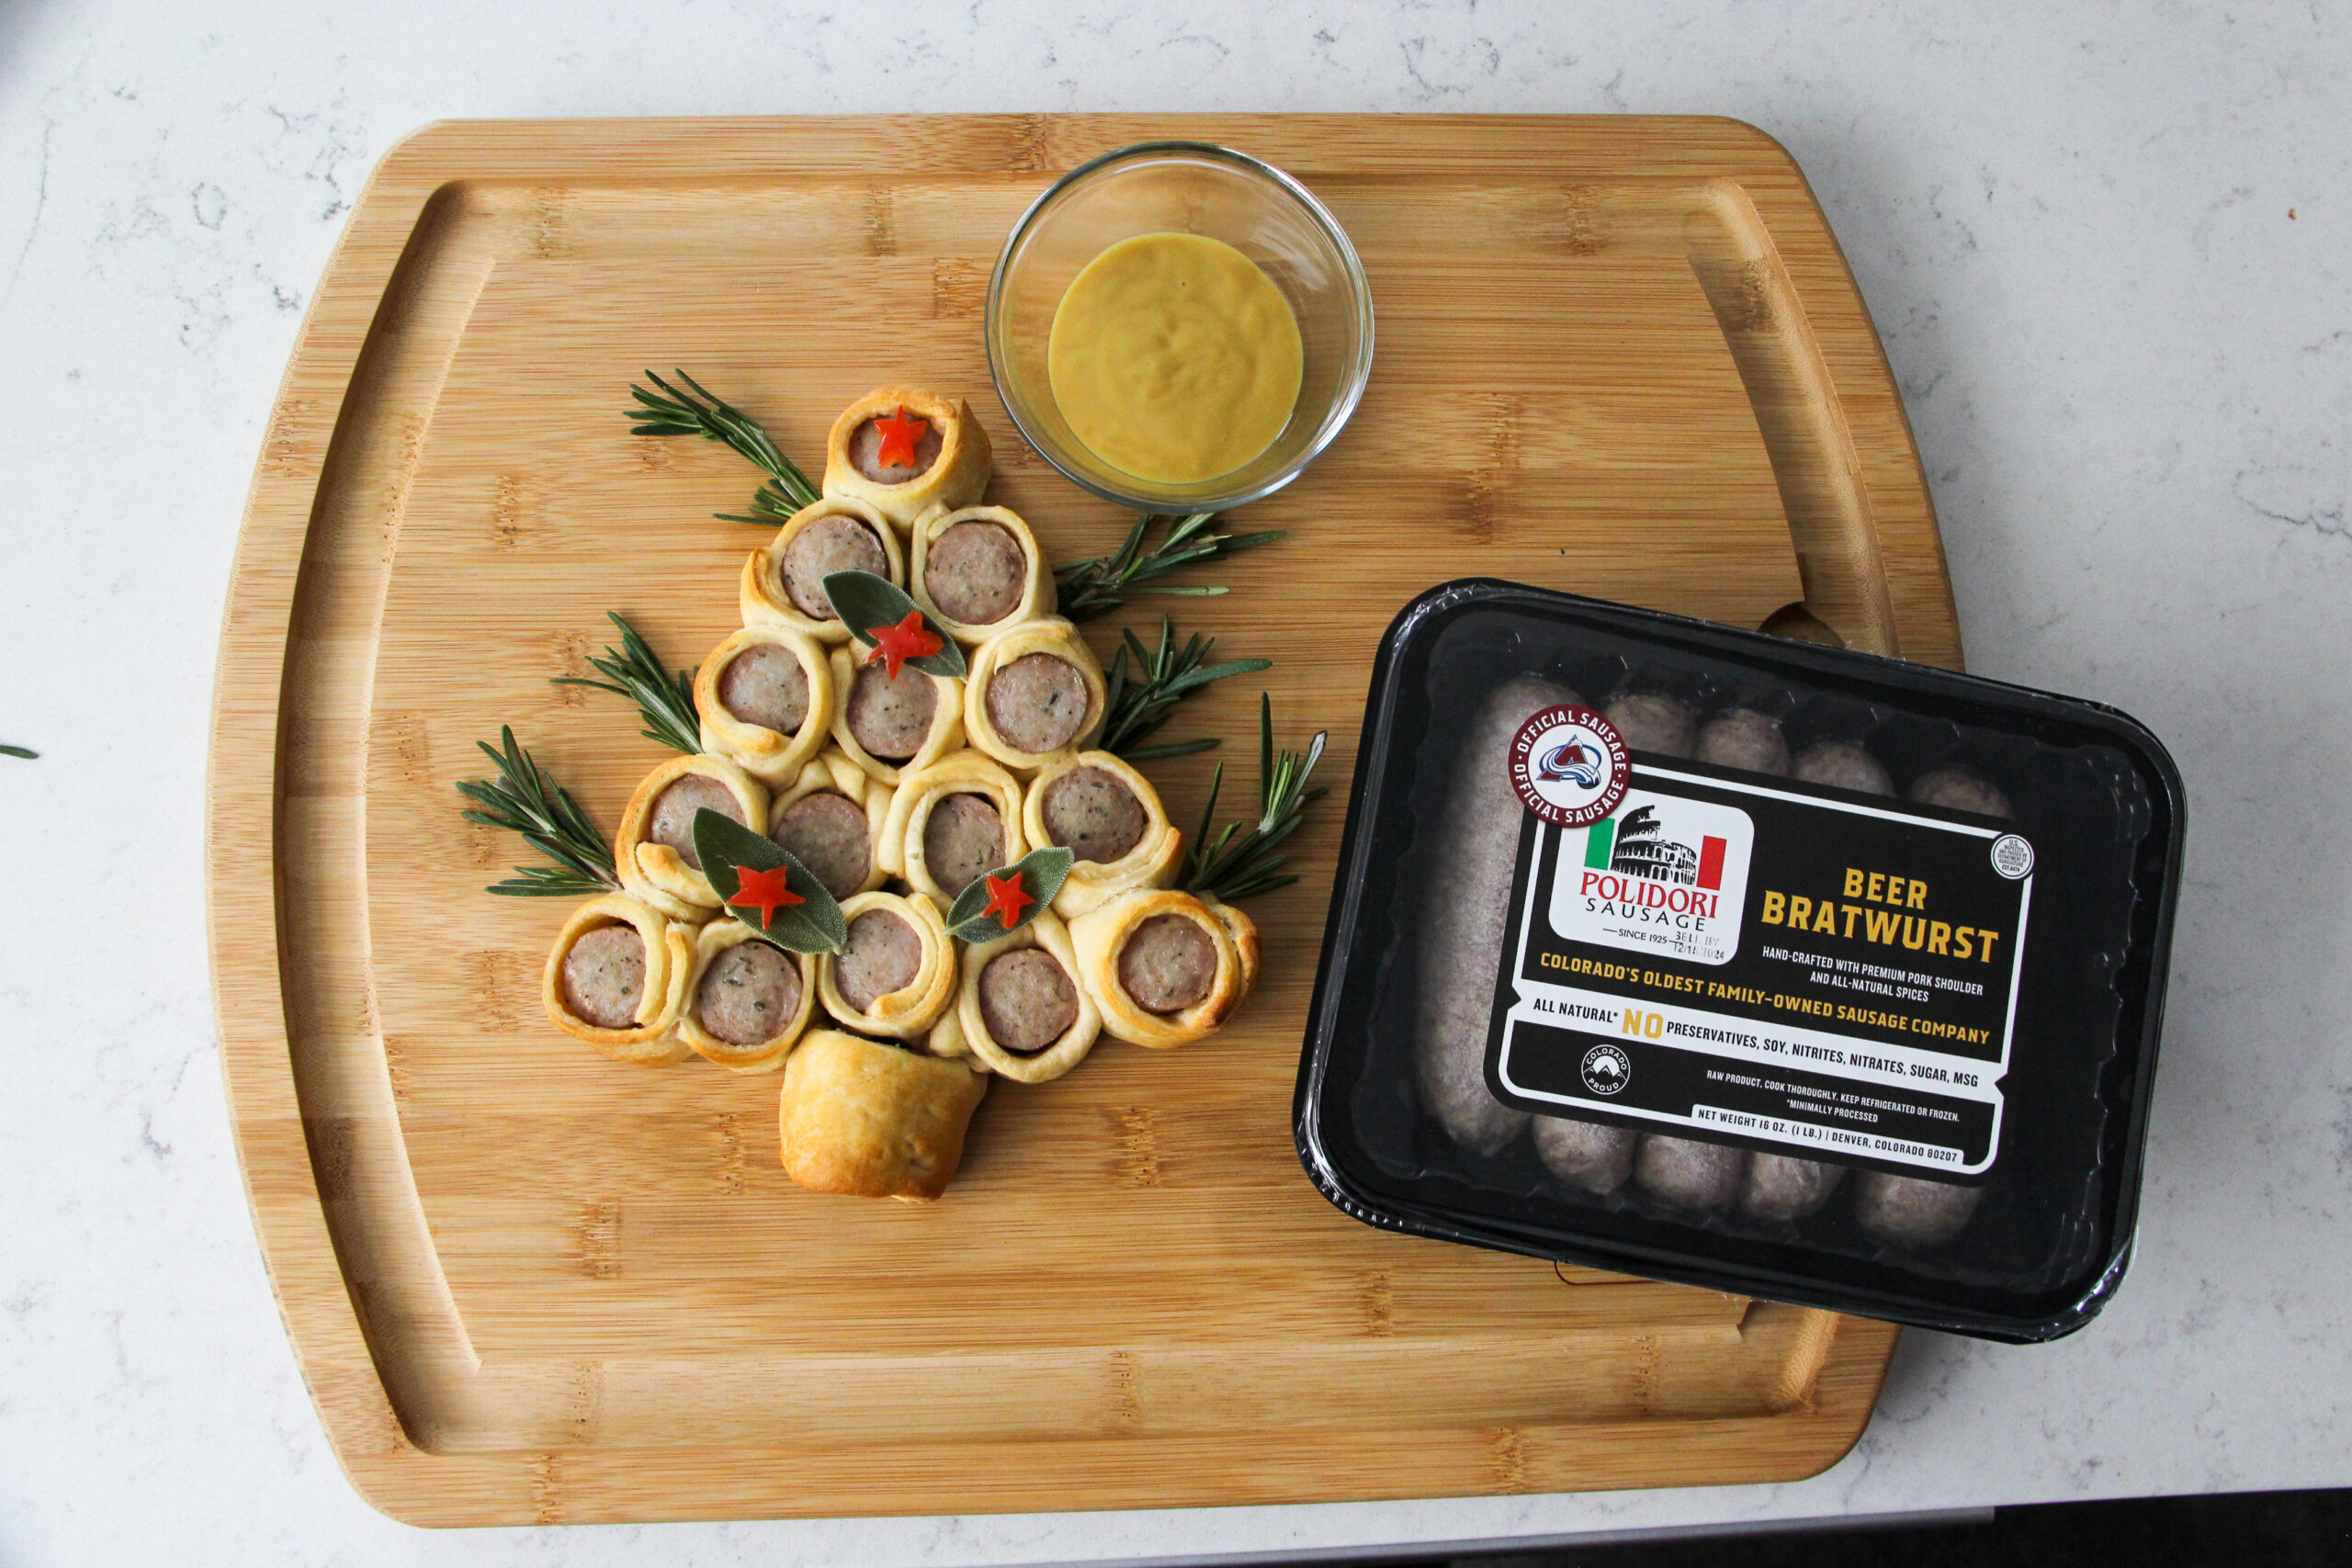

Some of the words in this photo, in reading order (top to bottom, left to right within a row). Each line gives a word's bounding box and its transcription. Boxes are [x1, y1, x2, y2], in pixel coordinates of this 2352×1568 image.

[1517, 710, 1576, 753] OFFICIAL
[1579, 712, 1627, 772] SAUSAGE
[1514, 764, 1559, 821] OFFICIAL
[1565, 780, 1624, 823] SAUSAGE
[1580, 872, 1718, 919] POLIDORI
[1843, 867, 1928, 910] BEER
[1585, 897, 1706, 932] SAUSAGE
[1618, 928, 1647, 941] SINCE
[1648, 933, 1668, 944] 1925
[1761, 890, 1999, 964] BRATWURST
[1762, 945, 1834, 969] HAND-CRAFTED
[1836, 958, 1860, 974] WITH
[1861, 964, 1906, 982] PREMIUM
[1907, 972, 1933, 987] PORK
[1934, 976, 1984, 996] SHOULDER
[1809, 971, 1830, 985] AND
[1831, 975, 1894, 997] ALL-NATURAL
[1895, 986, 1929, 1002] SPICES
[1541, 953, 1640, 982] COLORADO'S
[1644, 970, 1705, 994] OLDEST
[1708, 982, 1834, 1017] FAMILY-OWNED
[1837, 1005, 1908, 1031] SAUSAGE
[1912, 1019, 1990, 1044] COMPANY
[1532, 998, 1555, 1013] ALL
[1623, 1009, 1664, 1039] NO
[1666, 1021, 1759, 1050] PRESERVATIVES,
[1763, 1038, 1788, 1055] SOY,
[1792, 1043, 1846, 1066] NITRITES,
[1849, 1053, 1906, 1076] NITRATES,
[1909, 1064, 1950, 1084] SUGAR,
[1953, 1071, 1978, 1088] MSG
[1587, 1048, 1627, 1070] COLORADO
[1588, 1077, 1619, 1092] PROUD
[1706, 1069, 1724, 1081] RAW
[1724, 1073, 1763, 1089] PRODUCT.
[1764, 1079, 1786, 1092] COOK
[1787, 1083, 1838, 1101] THOROUGHLY.
[1840, 1093, 1860, 1104] KEEP
[1860, 1097, 1916, 1114] REFRIGERATED
[1917, 1106, 1928, 1117] OR
[1928, 1108, 1960, 1122] FROZEN.
[1698, 1109, 1717, 1121] NET
[1720, 1112, 1757, 1128] WEIGHT
[1758, 1120, 1770, 1130] 16
[1772, 1122, 1787, 1134] OZ.
[1792, 1124, 1800, 1136] (1
[1803, 1127, 1822, 1141] LB.)
[1831, 1132, 1871, 1148] DENVER,
[1874, 1139, 1925, 1156] COLORADO
[1927, 1148, 1957, 1162] 80207
[1834, 1107, 1879, 1123] PROCESSED
